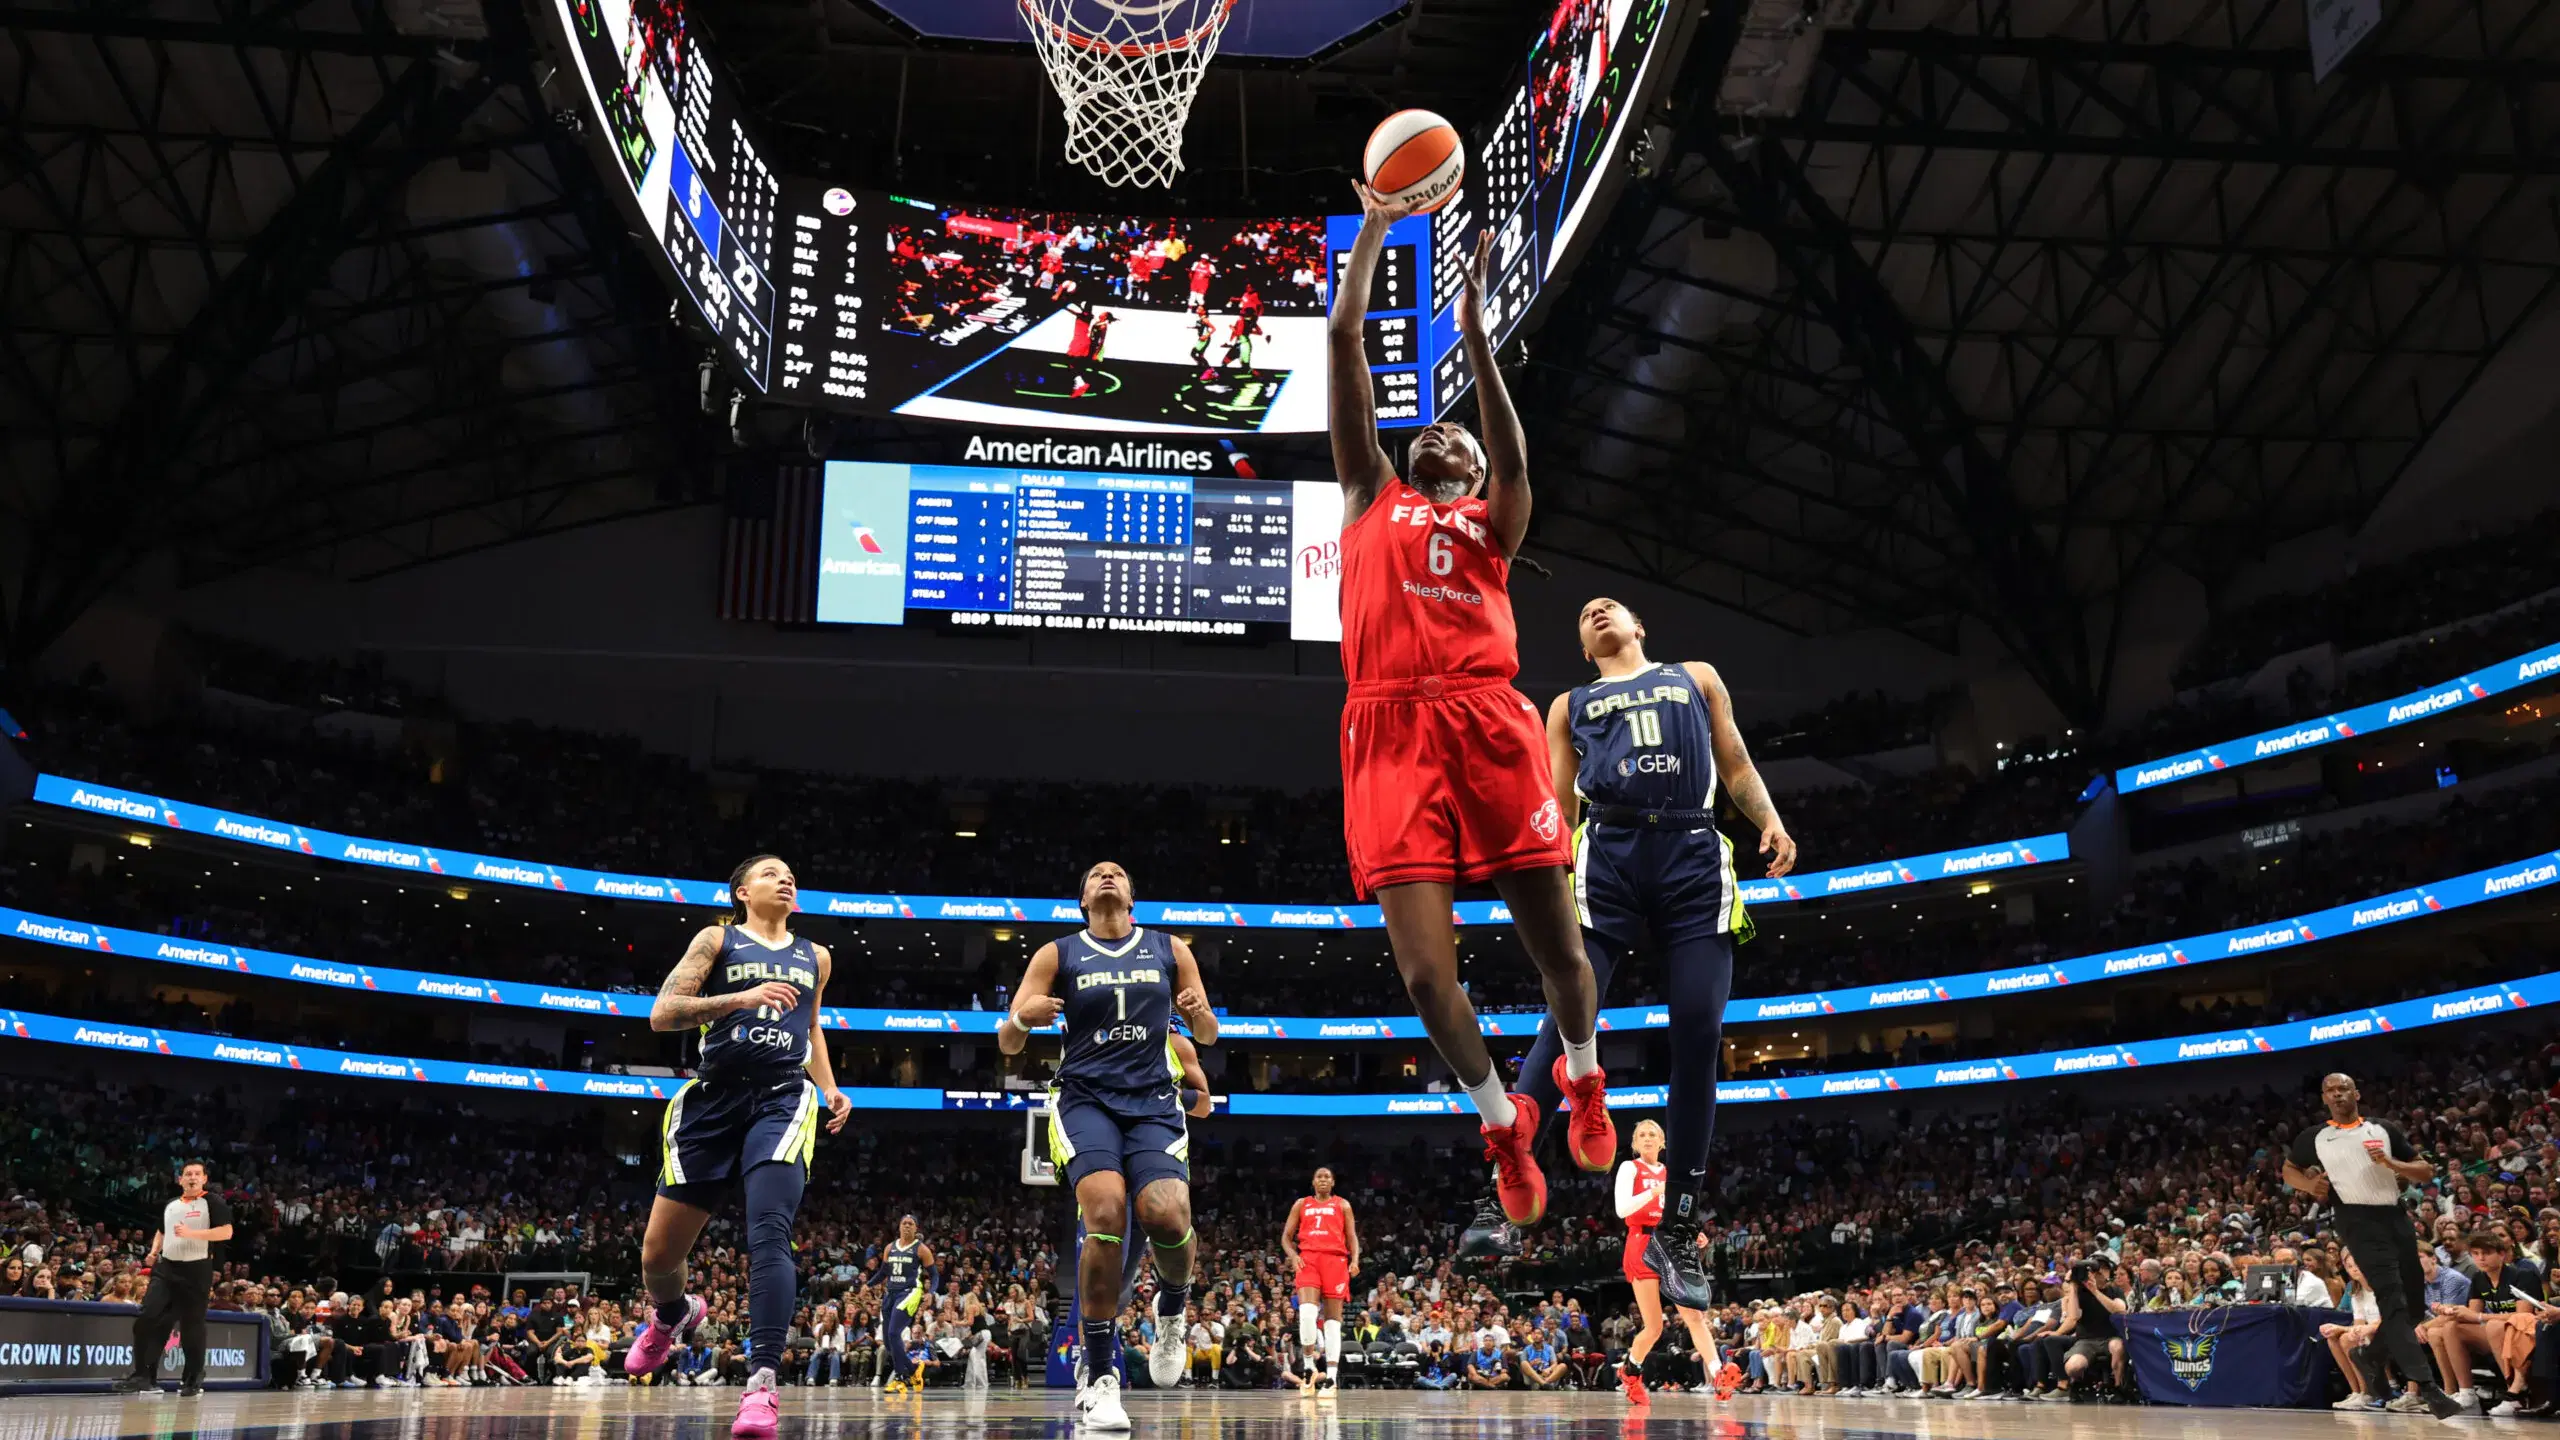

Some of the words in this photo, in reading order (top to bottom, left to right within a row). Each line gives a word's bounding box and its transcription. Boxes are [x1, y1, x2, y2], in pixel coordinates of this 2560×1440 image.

[687, 172, 703, 219] 5
[848, 224, 859, 237] 7
[795, 231, 813, 245] TO
[847, 241, 857, 253] 4
[847, 256, 856, 269] 1
[1387, 264, 1397, 276] 2
[732, 249, 758, 307] 22
[845, 272, 855, 284] 2
[1388, 295, 1397, 307] 1
[964, 435, 1101, 466] American
[1104, 441, 1213, 472] Airlines
[1390, 503, 1488, 549] FEVER
[1323, 540, 1338, 560] D
[1428, 532, 1454, 576] 6
[1296, 545, 1341, 580] Pep
[994, 613, 1042, 628] WINGS
[1086, 617, 1106, 630] AT
[1109, 618, 1246, 636] DALLASWINGS.COM
[1585, 685, 1690, 721] DALLAS
[2388, 689, 2463, 723] American
[1624, 709, 1663, 748] 10
[2255, 726, 2330, 756] American
[1637, 754, 1682, 776] GEM
[2136, 758, 2204, 786] American
[72, 789, 156, 819] American
[215, 817, 291, 846] American
[345, 843, 421, 867] American
[1943, 851, 2013, 874] American
[474, 861, 545, 884] American
[1828, 870, 1893, 892] American
[2485, 865, 2557, 895] American
[595, 878, 664, 898] American
[1741, 885, 1779, 902] rican
[829, 898, 894, 915] American
[941, 902, 1006, 917] American
[1162, 907, 1226, 923] American
[1271, 909, 1335, 926] American
[2353, 899, 2419, 926] American
[17, 919, 90, 945] American
[2229, 929, 2295, 953] American
[158, 943, 229, 966] American
[2105, 952, 2168, 974] American
[291, 963, 356, 984] American
[725, 962, 815, 990] DALLAS
[1076, 968, 1161, 991] DALLAS
[1987, 970, 2049, 993] American
[418, 978, 483, 998] American
[1870, 986, 1930, 1006] American
[540, 992, 602, 1010] American
[1114, 987, 1126, 1021] 1
[1758, 1001, 1817, 1018] American
[2432, 994, 2503, 1019] American
[885, 1013, 943, 1029] American
[1320, 1023, 1377, 1037] American
[2310, 1016, 2372, 1041] American
[75, 1027, 149, 1049] American
[748, 1026, 794, 1051] GEM
[1108, 1024, 1147, 1041] GEM
[214, 1043, 282, 1064] American
[2179, 1038, 2249, 1058] American
[341, 1058, 407, 1077] American
[1936, 1062, 1998, 1083] American
[2054, 1052, 2117, 1072] American
[466, 1069, 529, 1087] American
[584, 1079, 645, 1095] American
[1823, 1074, 1881, 1094] American
[1388, 1098, 1445, 1113] American
[1314, 1215, 1322, 1229] 7
[0, 1343, 62, 1366] CROWN
[66, 1344, 81, 1366] IS
[86, 1344, 133, 1367] YOURS
[2173, 1358, 2212, 1373] WINGS
